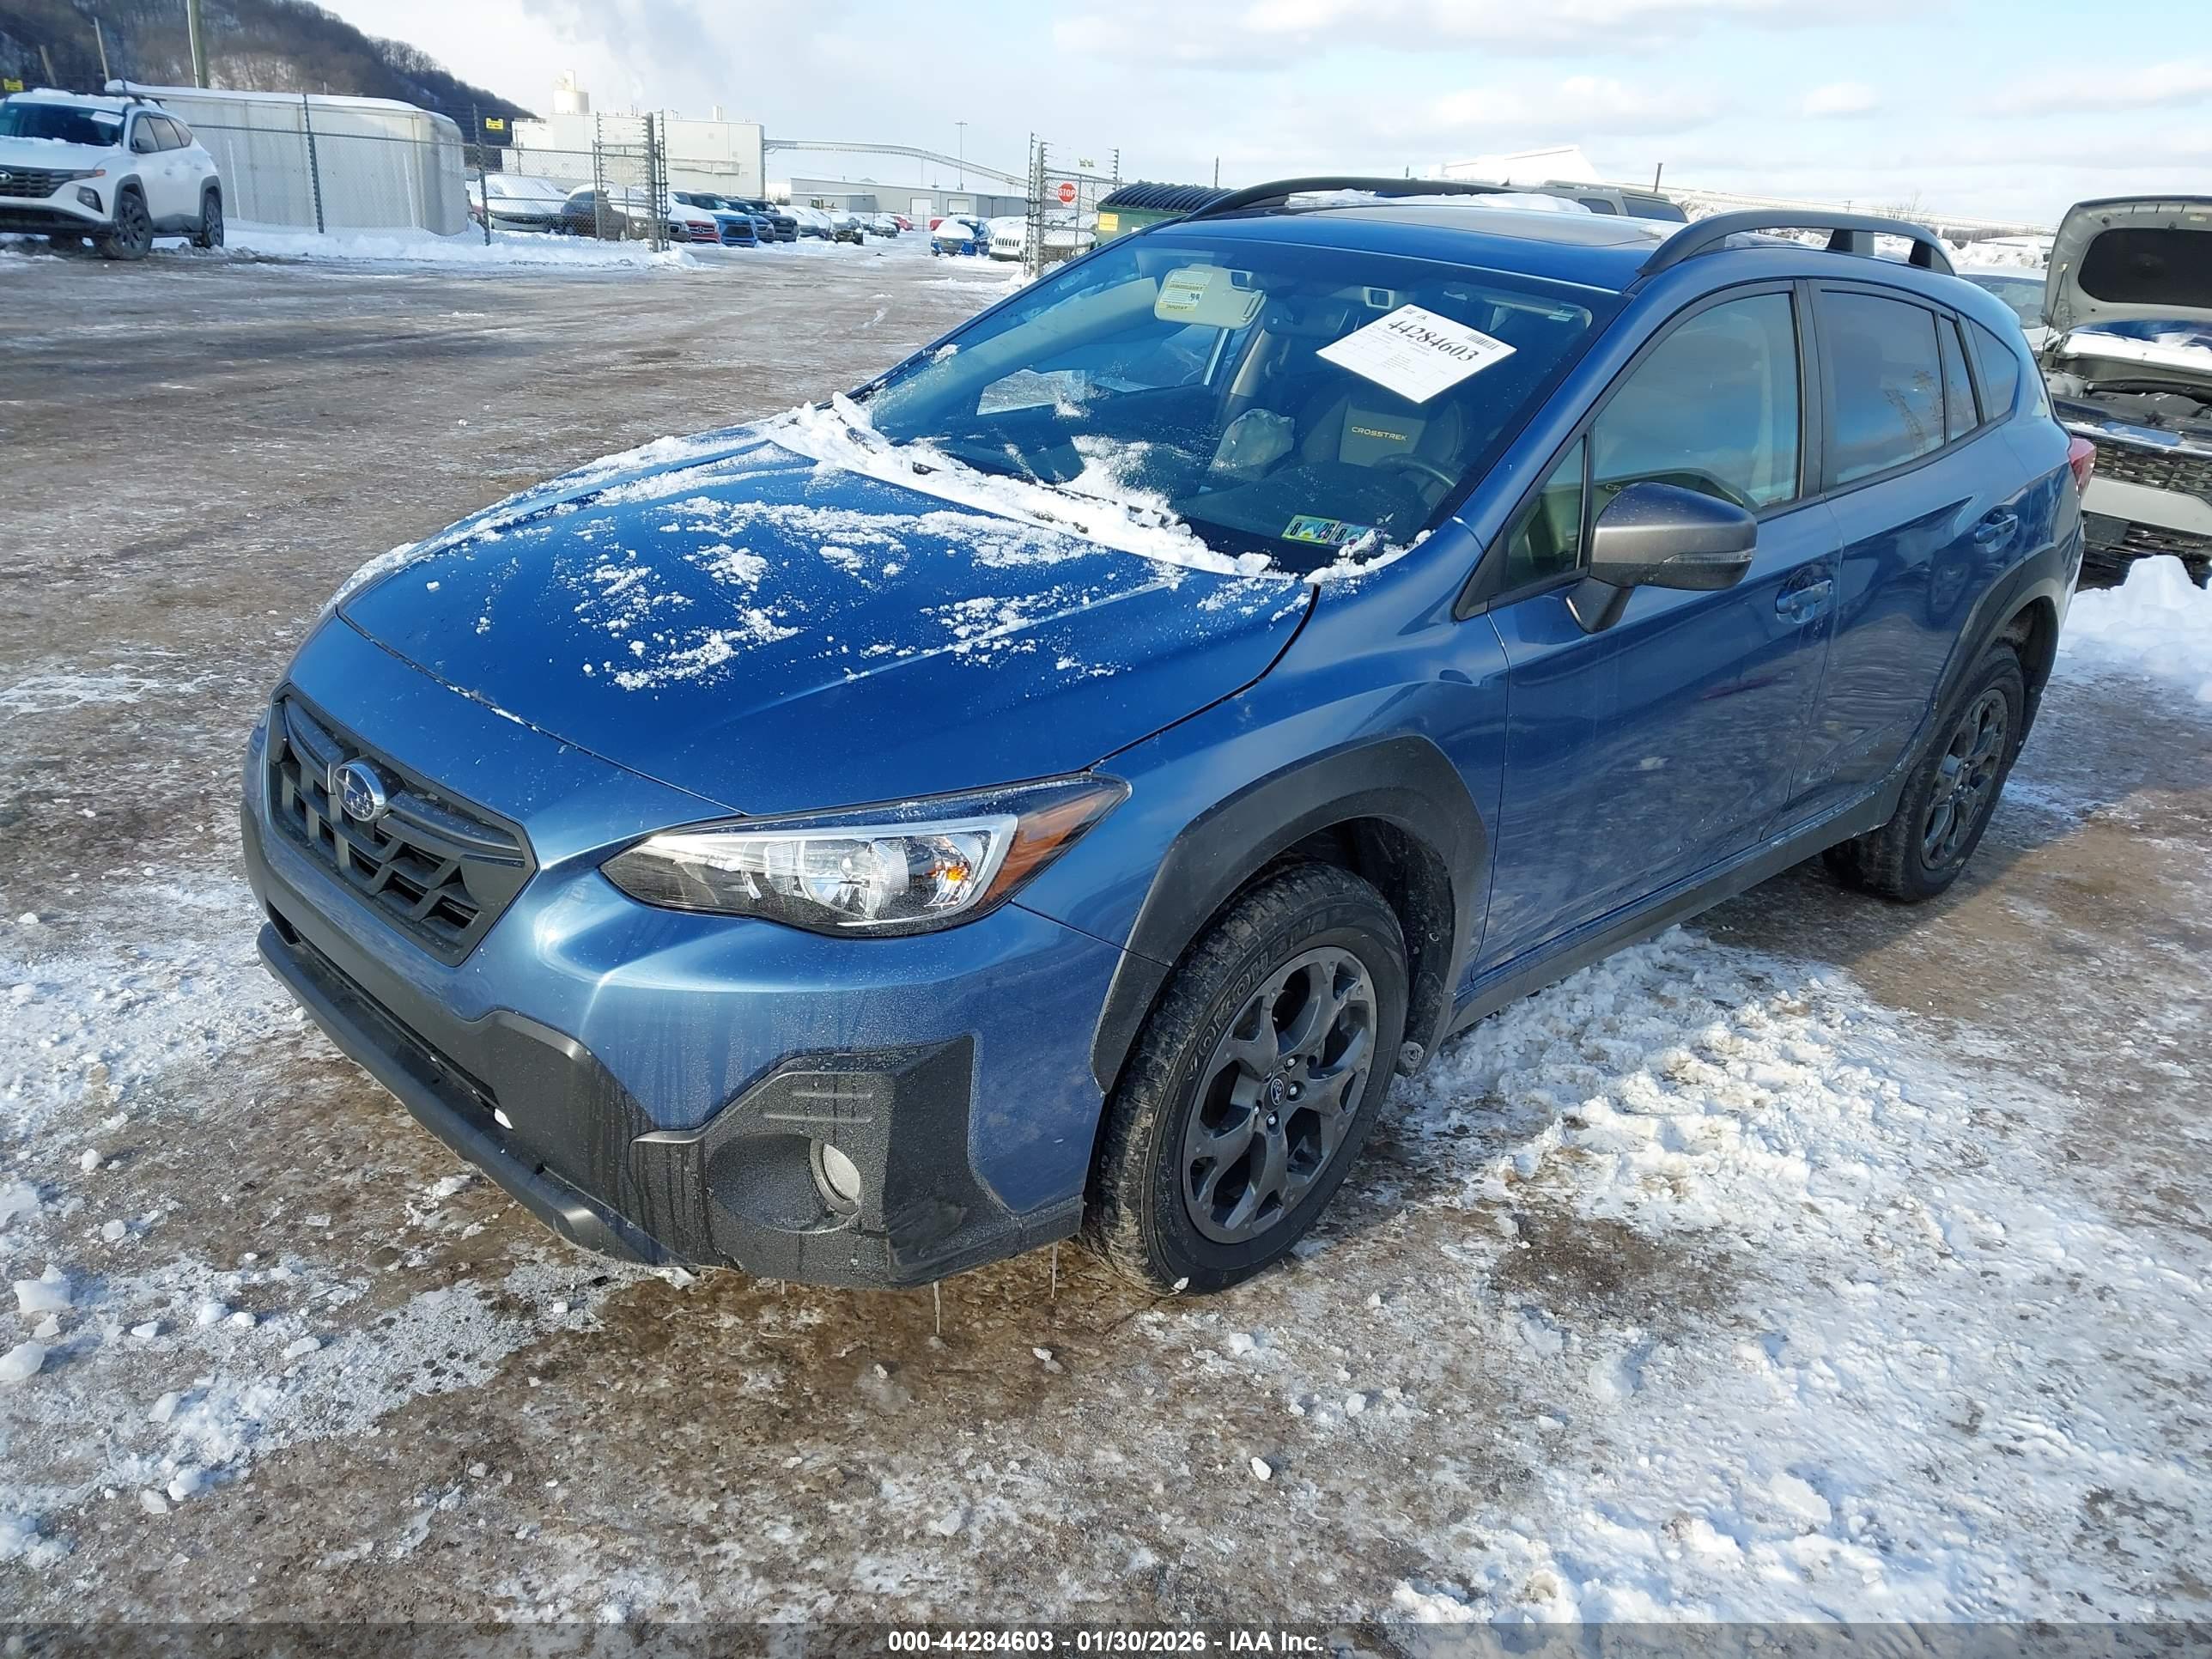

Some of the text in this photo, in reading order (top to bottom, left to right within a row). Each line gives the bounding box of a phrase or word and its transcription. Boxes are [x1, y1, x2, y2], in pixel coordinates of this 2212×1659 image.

[1058, 188, 1076, 198] STOP
[1387, 320, 1480, 362] 44284603
[1352, 426, 1408, 441] CROSSTREK
[1290, 521, 1302, 536] 8
